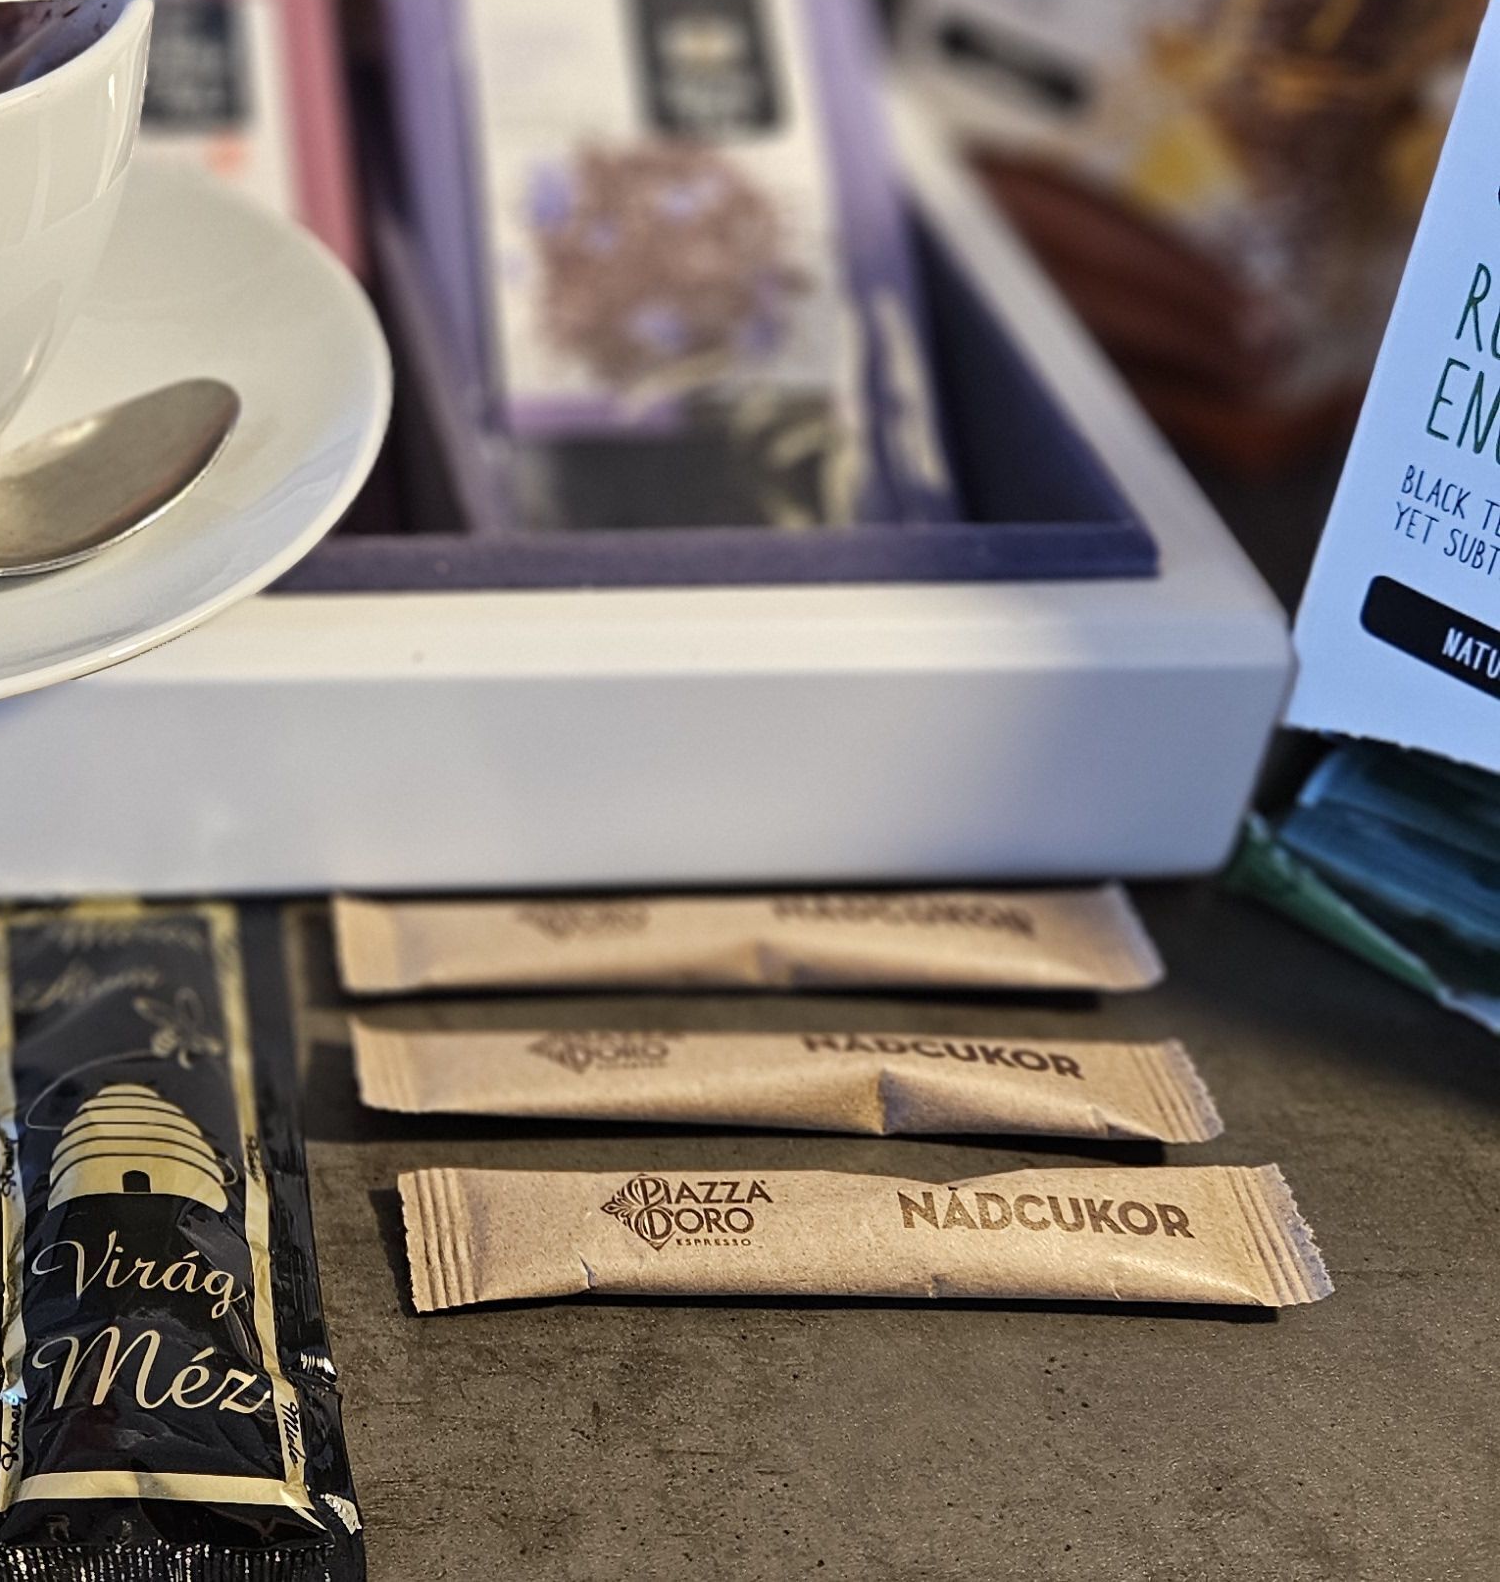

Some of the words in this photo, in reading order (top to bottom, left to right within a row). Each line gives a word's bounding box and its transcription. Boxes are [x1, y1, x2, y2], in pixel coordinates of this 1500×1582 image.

[1425, 357, 1500, 466] EN
[1401, 464, 1471, 519] BLACK
[1394, 501, 1440, 544] YET
[634, 1176, 774, 1206] PIAZZA
[896, 1185, 1196, 1239] NÁDCUKOR
[675, 1238, 752, 1247] ESPRESSO
[30, 1230, 247, 1319] Virág
[31, 1326, 273, 1414] Méz
[279, 1400, 303, 1470] Miele
